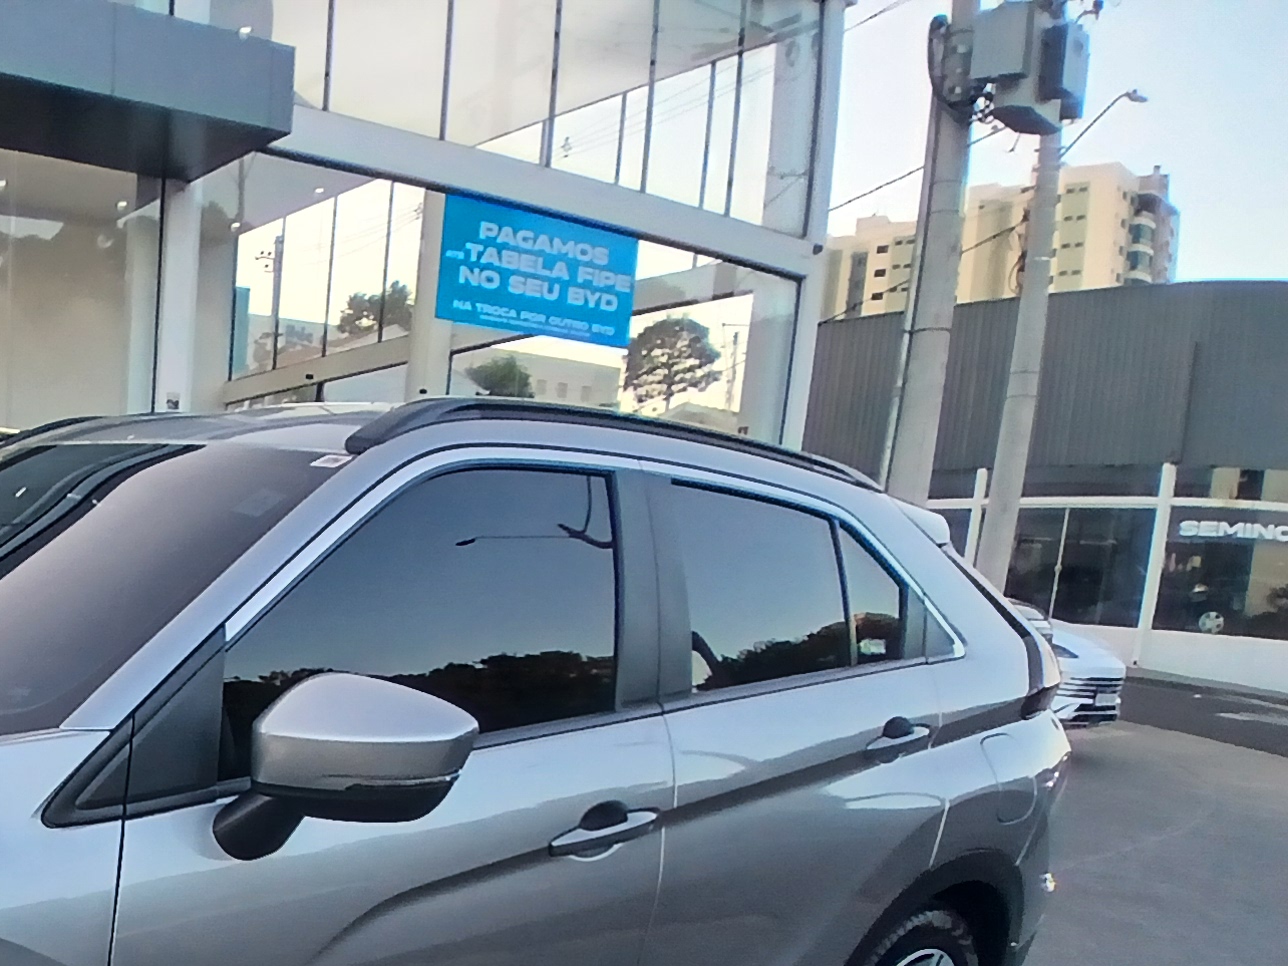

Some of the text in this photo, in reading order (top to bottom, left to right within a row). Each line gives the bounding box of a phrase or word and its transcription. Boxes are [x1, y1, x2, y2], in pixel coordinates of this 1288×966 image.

[478, 221, 610, 266] PAGAMOS
[458, 265, 619, 312] NO SEU BYD
[465, 242, 632, 293] TABELA FIPE
